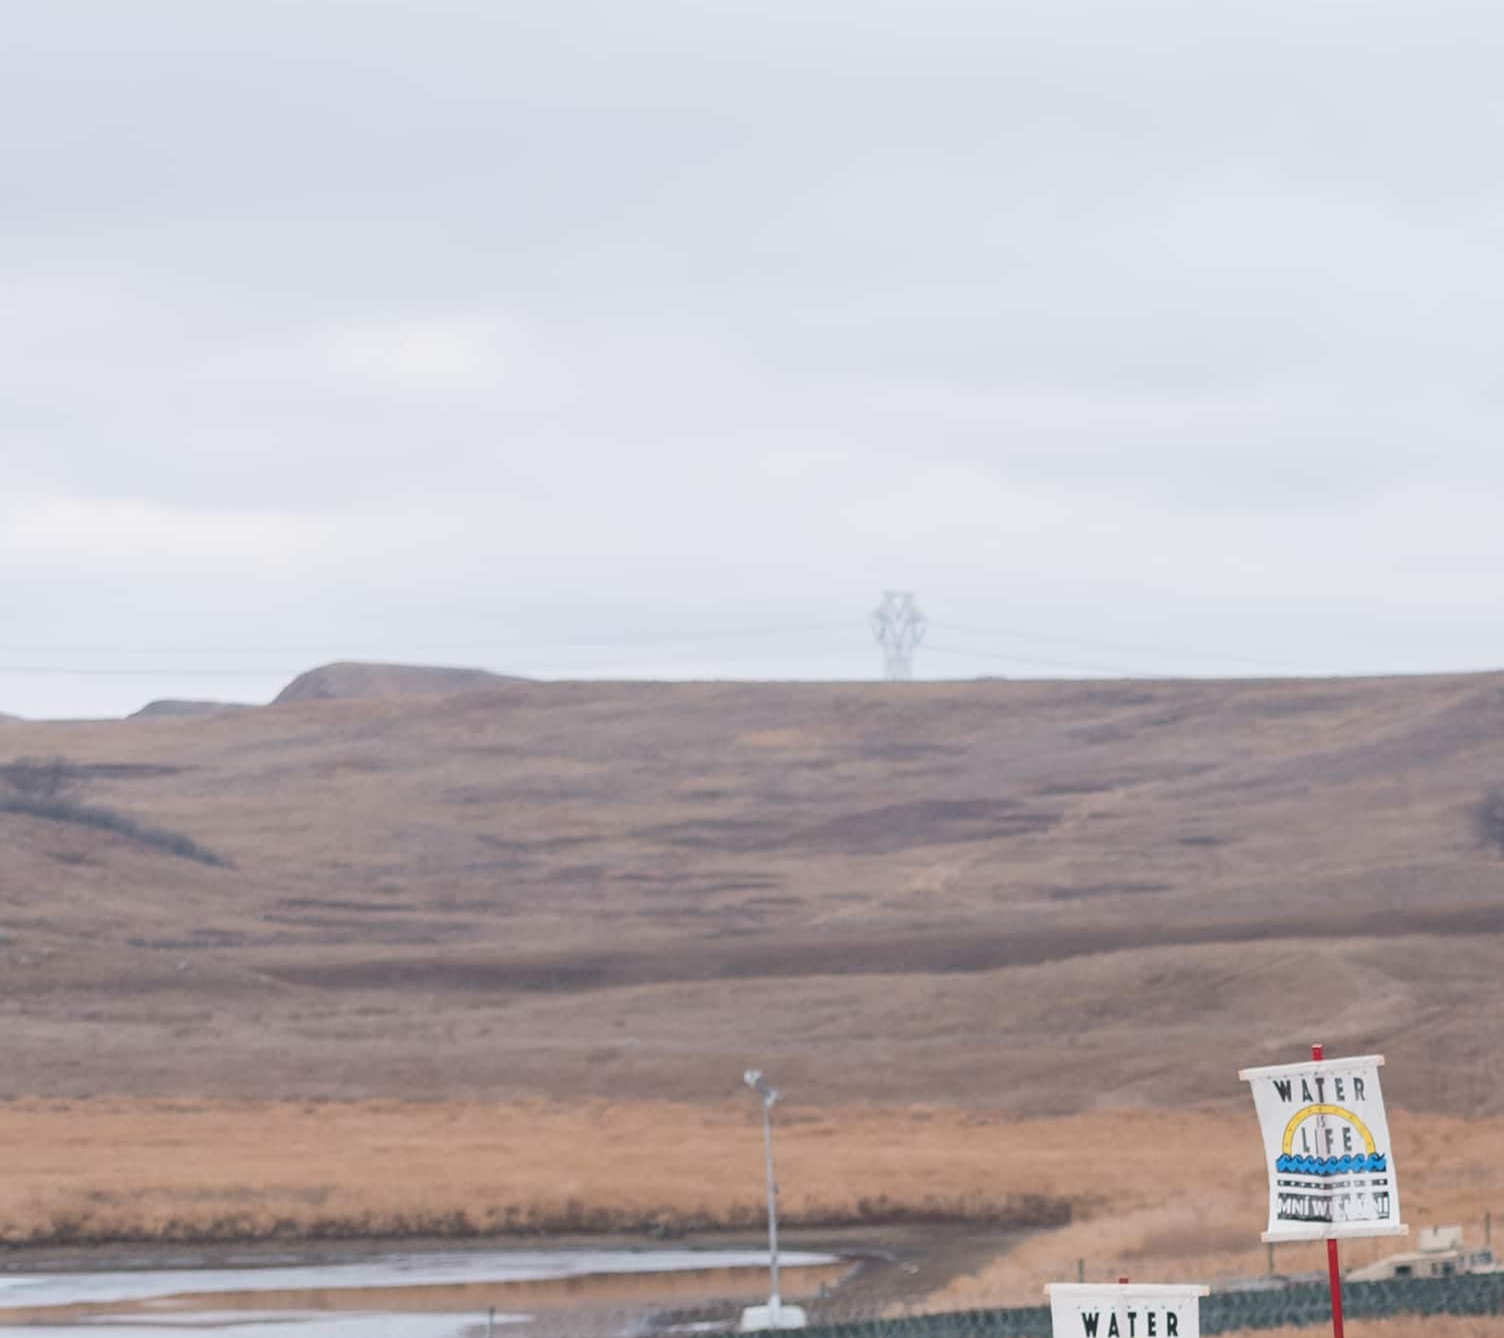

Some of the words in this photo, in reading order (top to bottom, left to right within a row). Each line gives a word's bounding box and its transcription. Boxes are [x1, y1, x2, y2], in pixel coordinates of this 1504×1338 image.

[1273, 1077, 1366, 1103] WATER
[1317, 1116, 1326, 1128] IS
[1301, 1127, 1352, 1155] LIFE
[1082, 1312, 1178, 1338] WATER
